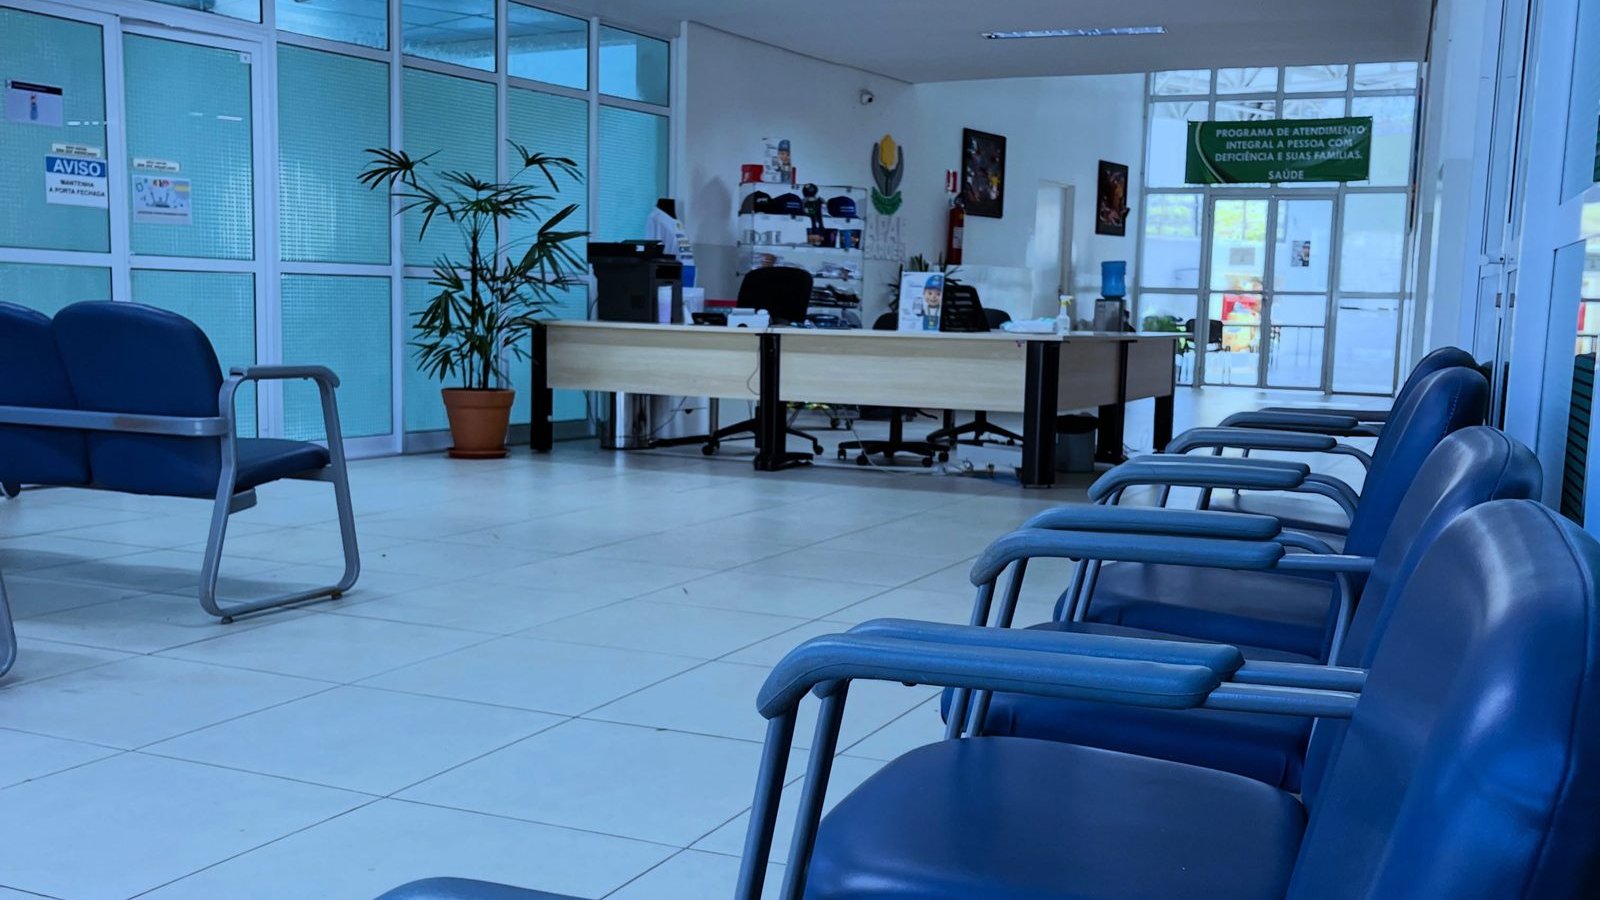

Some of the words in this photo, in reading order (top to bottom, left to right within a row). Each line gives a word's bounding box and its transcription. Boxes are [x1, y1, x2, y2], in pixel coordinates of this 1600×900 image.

[1216, 128, 1274, 138] PROGRAMA
[1276, 128, 1289, 137] DE
[1292, 126, 1366, 136] ATENDIMENTO
[1226, 140, 1273, 150] INTEGRAL
[1277, 140, 1284, 149] A
[1288, 139, 1325, 148] PESSOA
[1328, 138, 1353, 148] COM
[1215, 151, 1274, 162] DEFICIÊNCIA
[1278, 152, 1283, 161] E
[1286, 152, 1312, 161] SUAS
[53, 158, 101, 176] AVISO
[1268, 168, 1305, 180] SAÚDE
[60, 179, 94, 188] MANTENHA
[76, 189, 105, 197] FECHADA
